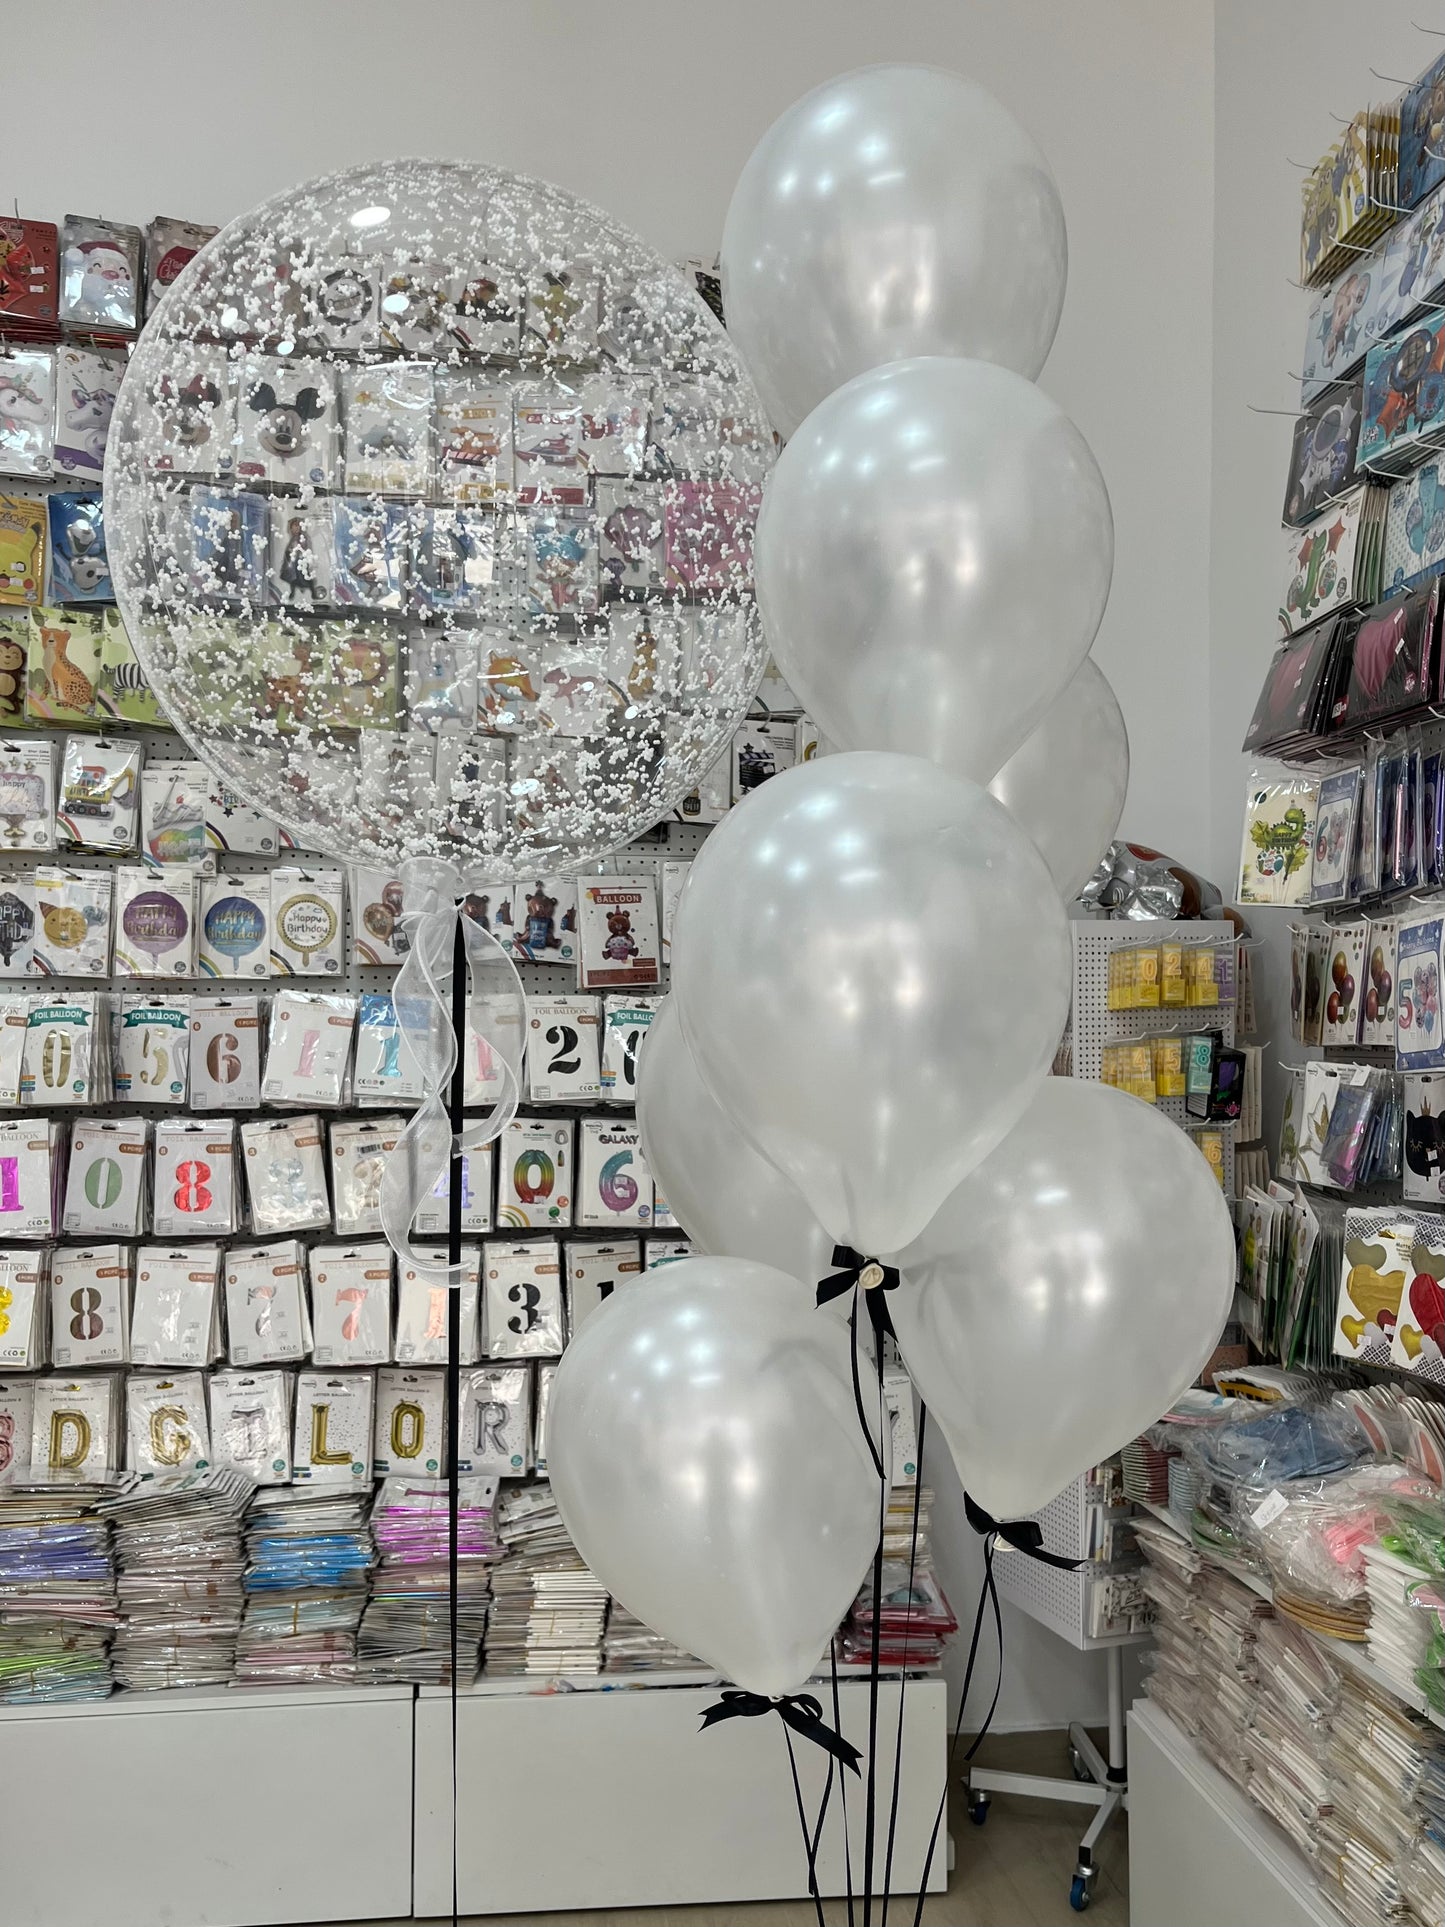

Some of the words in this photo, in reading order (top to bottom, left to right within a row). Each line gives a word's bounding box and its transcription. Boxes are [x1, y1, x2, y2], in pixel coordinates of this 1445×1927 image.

[215, 910, 255, 925] HAPPY
[293, 911, 322, 924] Happy
[597, 895, 639, 903] BALLOON
[287, 923, 328, 934] Birthday
[1142, 958, 1157, 981] 0
[1166, 952, 1182, 976] 2
[50, 1010, 82, 1019] BALLOON
[148, 1012, 181, 1021] BALLOON
[617, 1012, 631, 1020] FOIL
[633, 1013, 653, 1021] BALLO
[1399, 978, 1412, 1029] 5
[207, 1033, 241, 1084] 6
[292, 1029, 321, 1078] 1
[545, 1025, 581, 1075] 2
[1196, 1045, 1211, 1067] 8
[599, 1134, 640, 1144] GALAXY
[85, 1157, 123, 1209] 0
[174, 1160, 213, 1213] 8
[514, 1150, 555, 1204] 0
[599, 1150, 639, 1211] 6
[0, 1264, 29, 1272] LLOON
[70, 1287, 103, 1340] 8
[247, 1285, 277, 1338] 7
[335, 1287, 369, 1341] 7
[507, 1283, 541, 1335] 3
[49, 1409, 91, 1468] D
[150, 1405, 191, 1466] G
[311, 1402, 353, 1465] L
[473, 1399, 511, 1456] R
